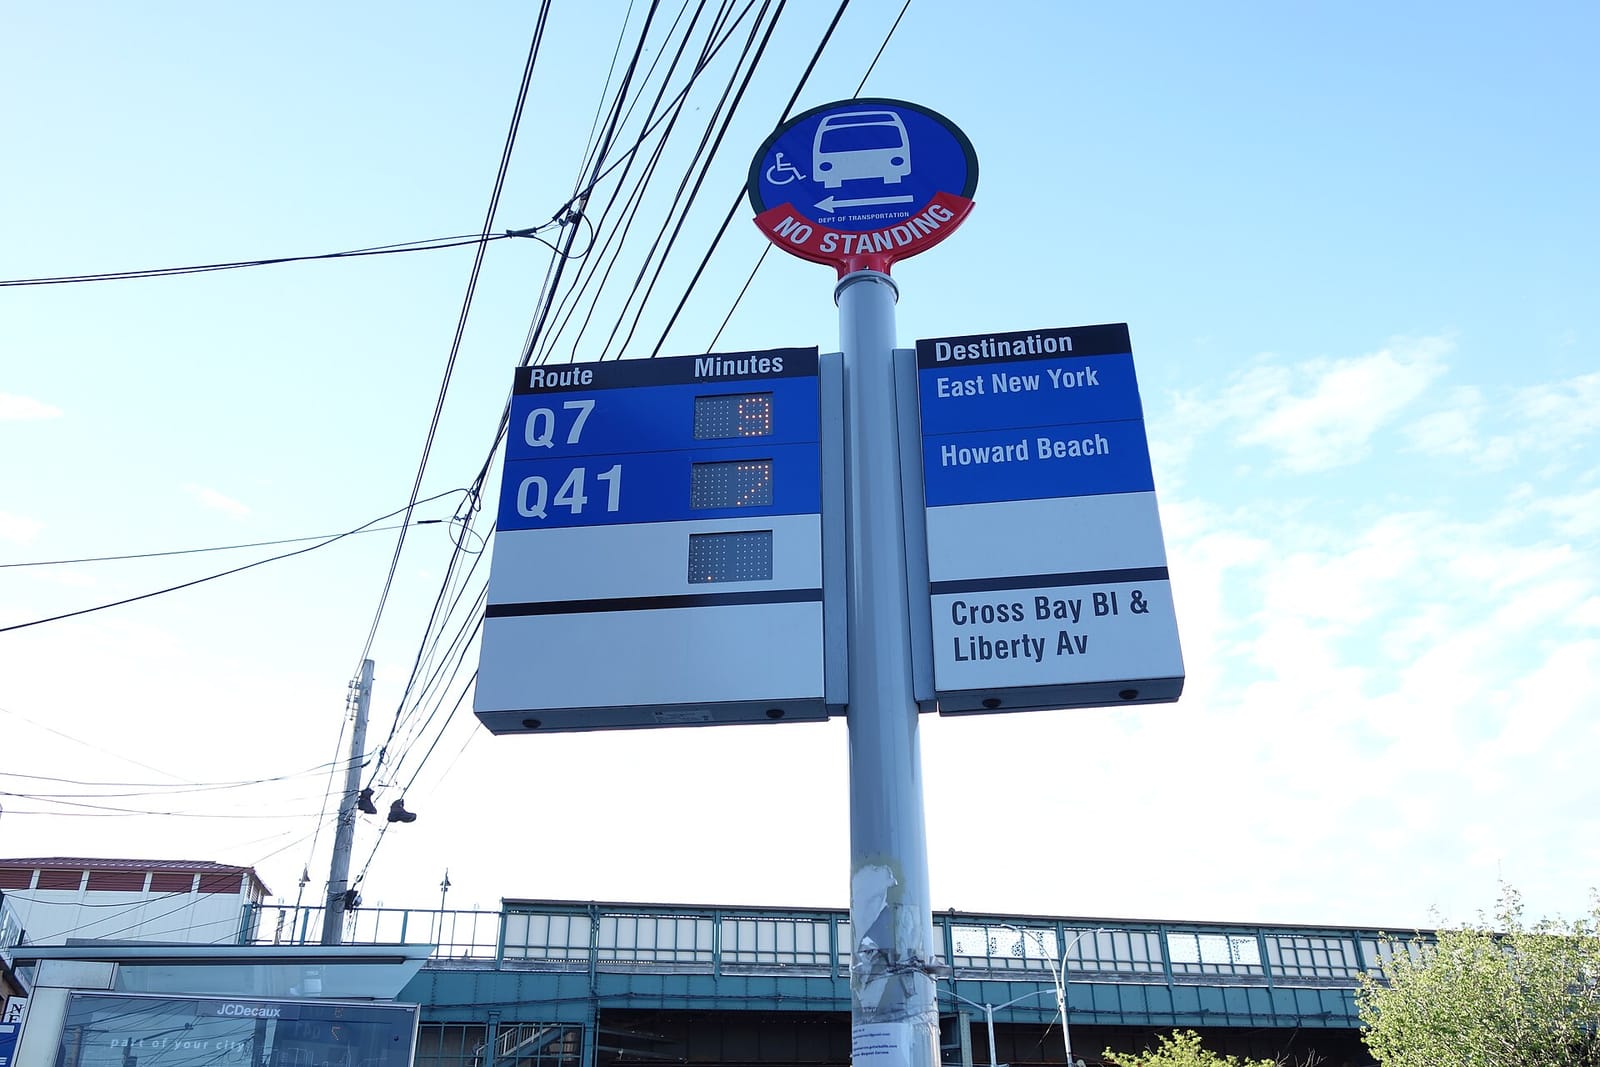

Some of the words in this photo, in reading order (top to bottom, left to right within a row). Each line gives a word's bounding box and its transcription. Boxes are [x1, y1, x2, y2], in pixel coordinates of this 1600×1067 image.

[772, 215, 813, 245] NO
[819, 205, 955, 254] STANDING
[848, 211, 910, 222] TRANSPORTATION
[935, 334, 1073, 362] Destination
[529, 366, 594, 389] Route
[694, 355, 784, 378] Minutes
[937, 375, 985, 398] East
[991, 371, 1040, 395] New
[1047, 366, 1100, 390] York
[524, 399, 596, 449] Q7
[738, 397, 770, 437] 9
[941, 437, 1029, 467] Howard
[1037, 433, 1110, 460] Beach
[516, 463, 622, 520] Q41
[736, 464, 770, 507] 7
[951, 598, 1025, 626] Cross
[1034, 595, 1082, 624] Bay
[1093, 591, 1119, 617] Bl
[1129, 589, 1150, 615] &
[953, 633, 1046, 663] Liberty
[1056, 629, 1089, 656] Av
[216, 1003, 281, 1017] JCDecaux
[110, 1037, 143, 1049] part
[152, 1037, 166, 1048] of
[174, 1039, 209, 1051] your
[215, 1039, 245, 1053] city
